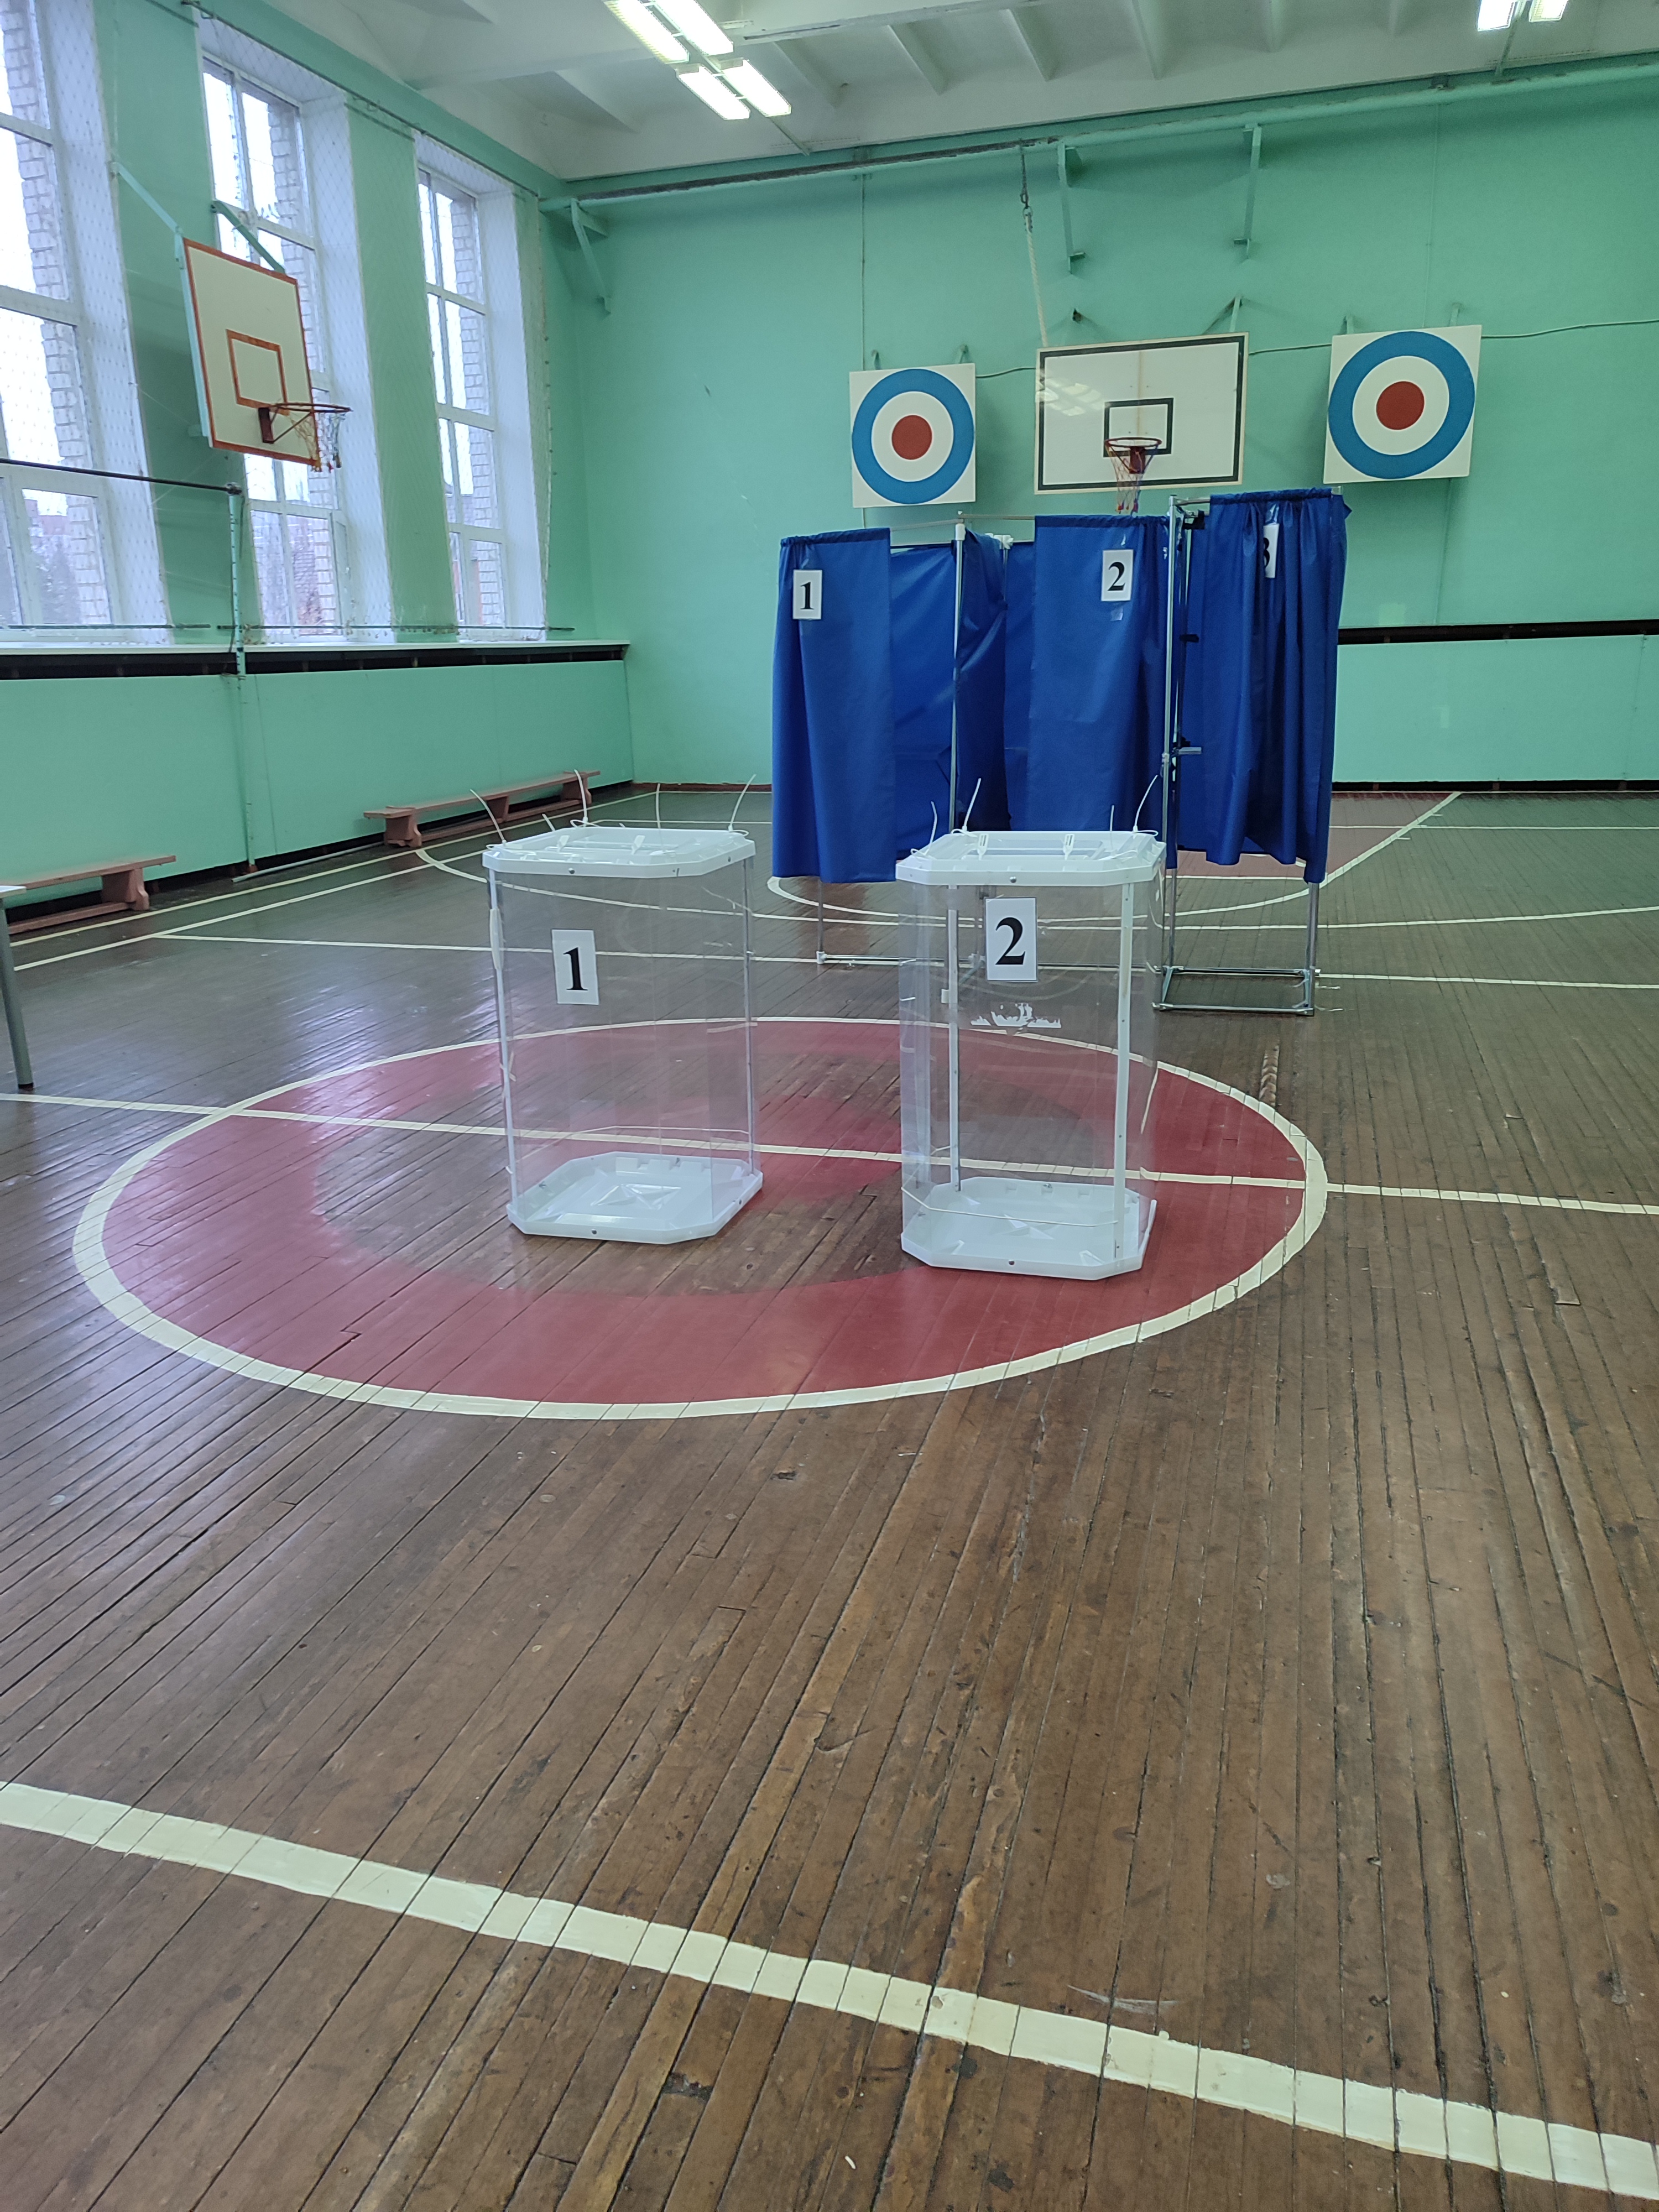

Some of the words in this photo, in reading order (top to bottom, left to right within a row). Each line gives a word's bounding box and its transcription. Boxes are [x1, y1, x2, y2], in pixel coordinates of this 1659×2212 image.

[1107, 561, 1125, 591] 2
[800, 581, 814, 610] 1
[995, 917, 1026, 965] 2
[562, 947, 588, 991] 1
